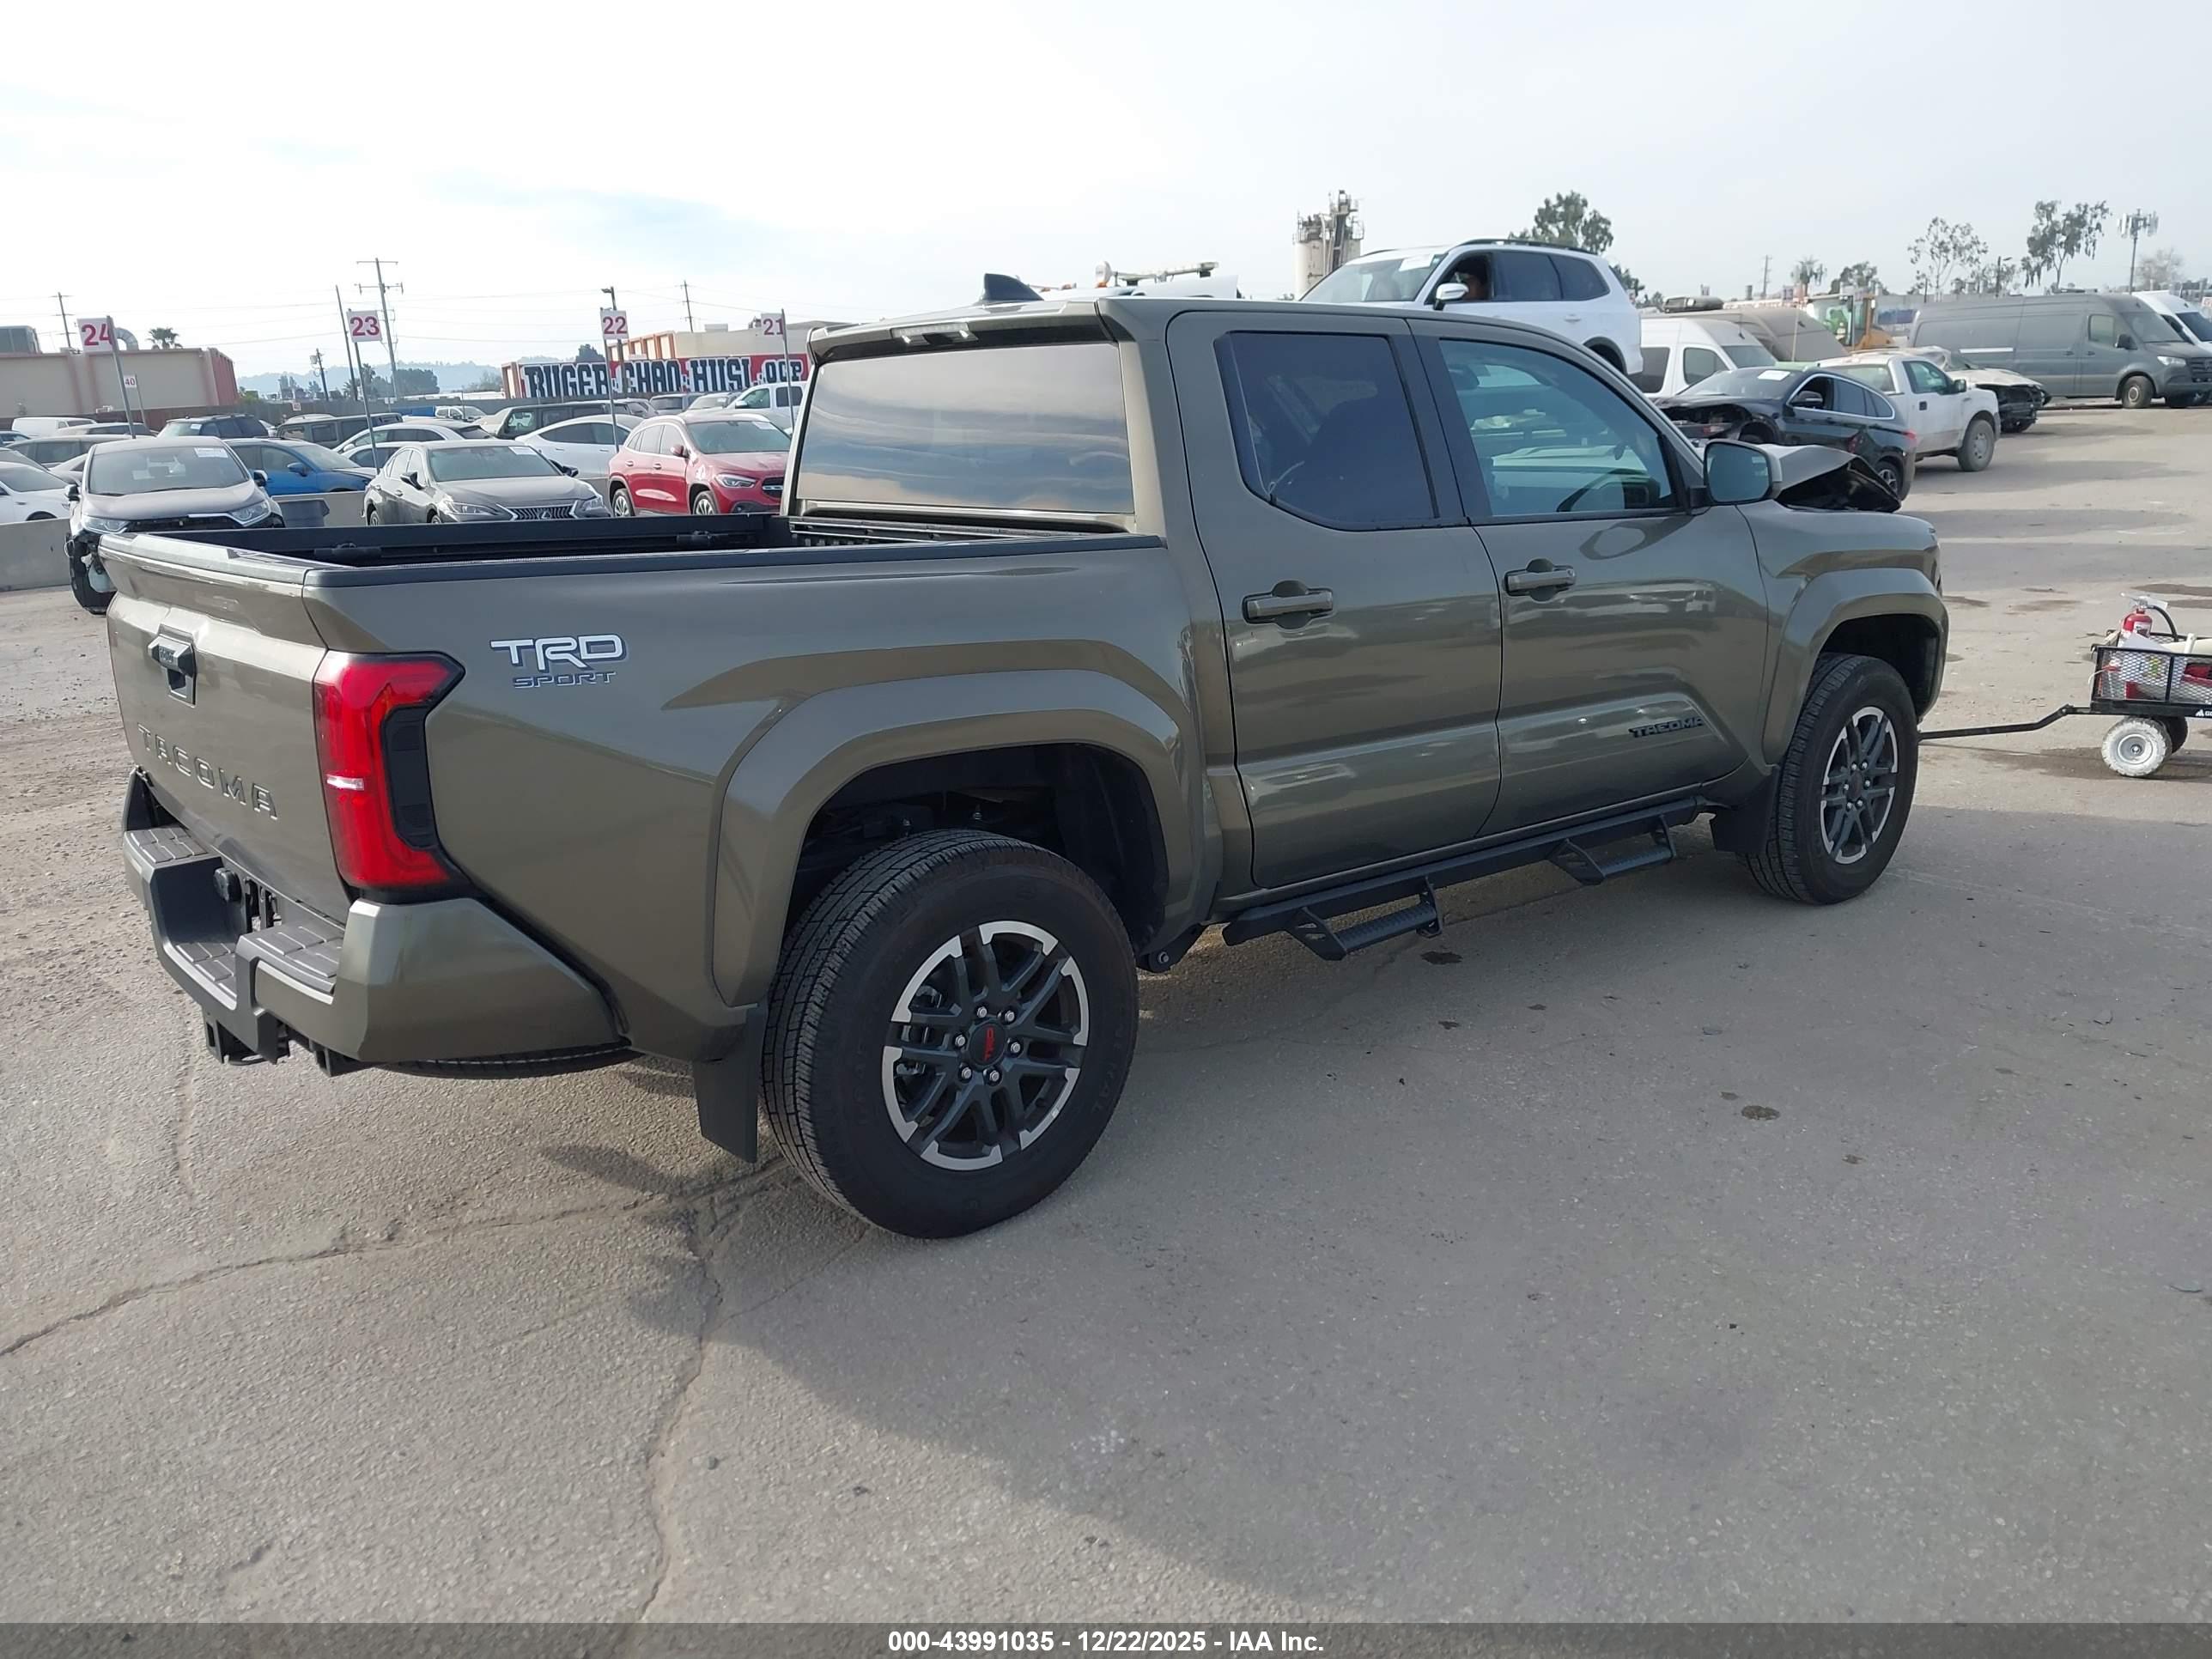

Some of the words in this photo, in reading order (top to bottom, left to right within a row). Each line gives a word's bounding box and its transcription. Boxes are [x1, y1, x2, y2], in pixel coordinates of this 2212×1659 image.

[81, 323, 111, 347] 24
[351, 315, 380, 337] 23
[602, 316, 628, 335] 22
[489, 634, 626, 673] TRD
[513, 671, 617, 689] SPORT
[1628, 717, 1704, 738] TACOMA
[137, 723, 278, 820] TACOMA
